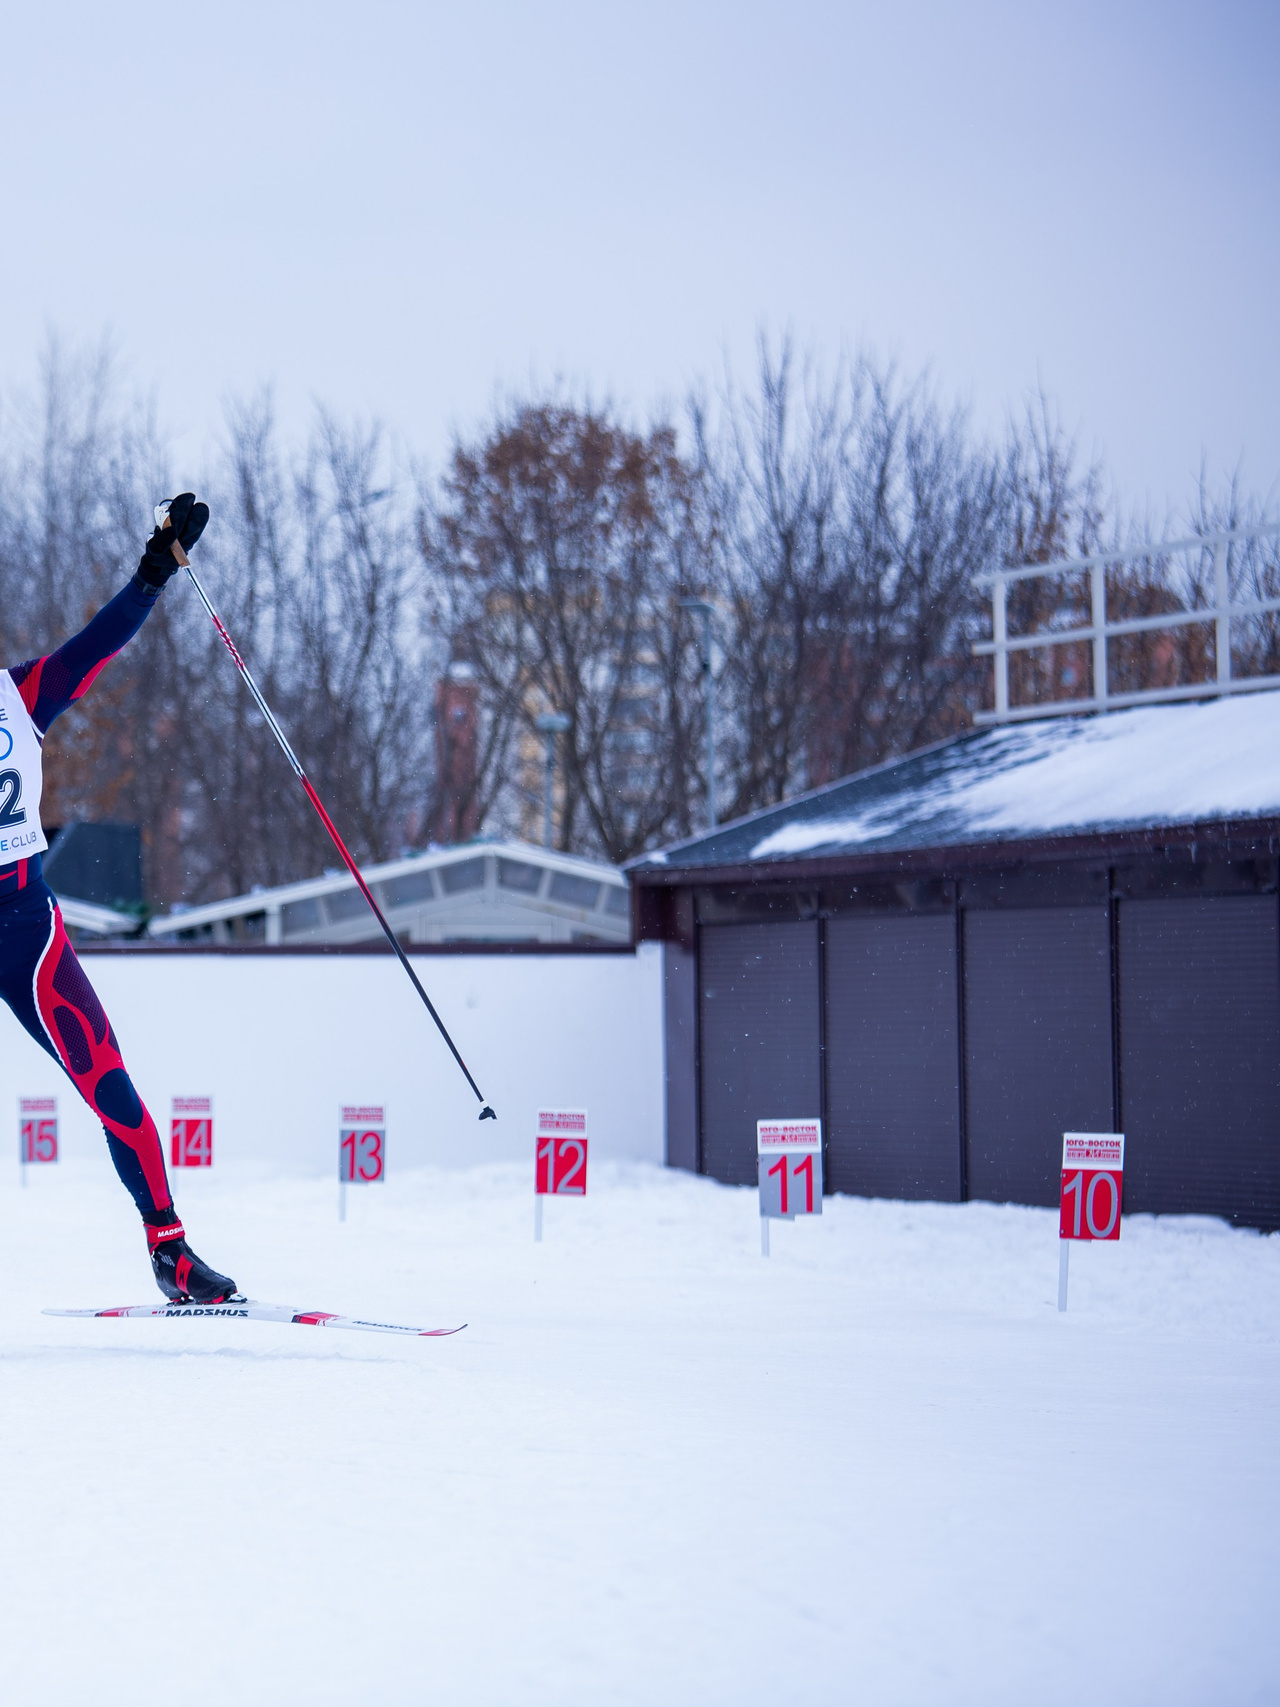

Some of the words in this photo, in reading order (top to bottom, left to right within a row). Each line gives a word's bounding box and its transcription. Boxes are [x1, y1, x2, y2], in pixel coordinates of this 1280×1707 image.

[21, 1120, 58, 1163] 15
[173, 1120, 210, 1165] 14
[341, 1130, 383, 1182] 13
[1066, 1139, 1121, 1148] ЮГО-ВОСТОК
[538, 1139, 585, 1193] 12
[768, 1154, 813, 1214] 11
[1063, 1171, 1118, 1238] 10
[166, 1308, 249, 1317] MADSHUS
